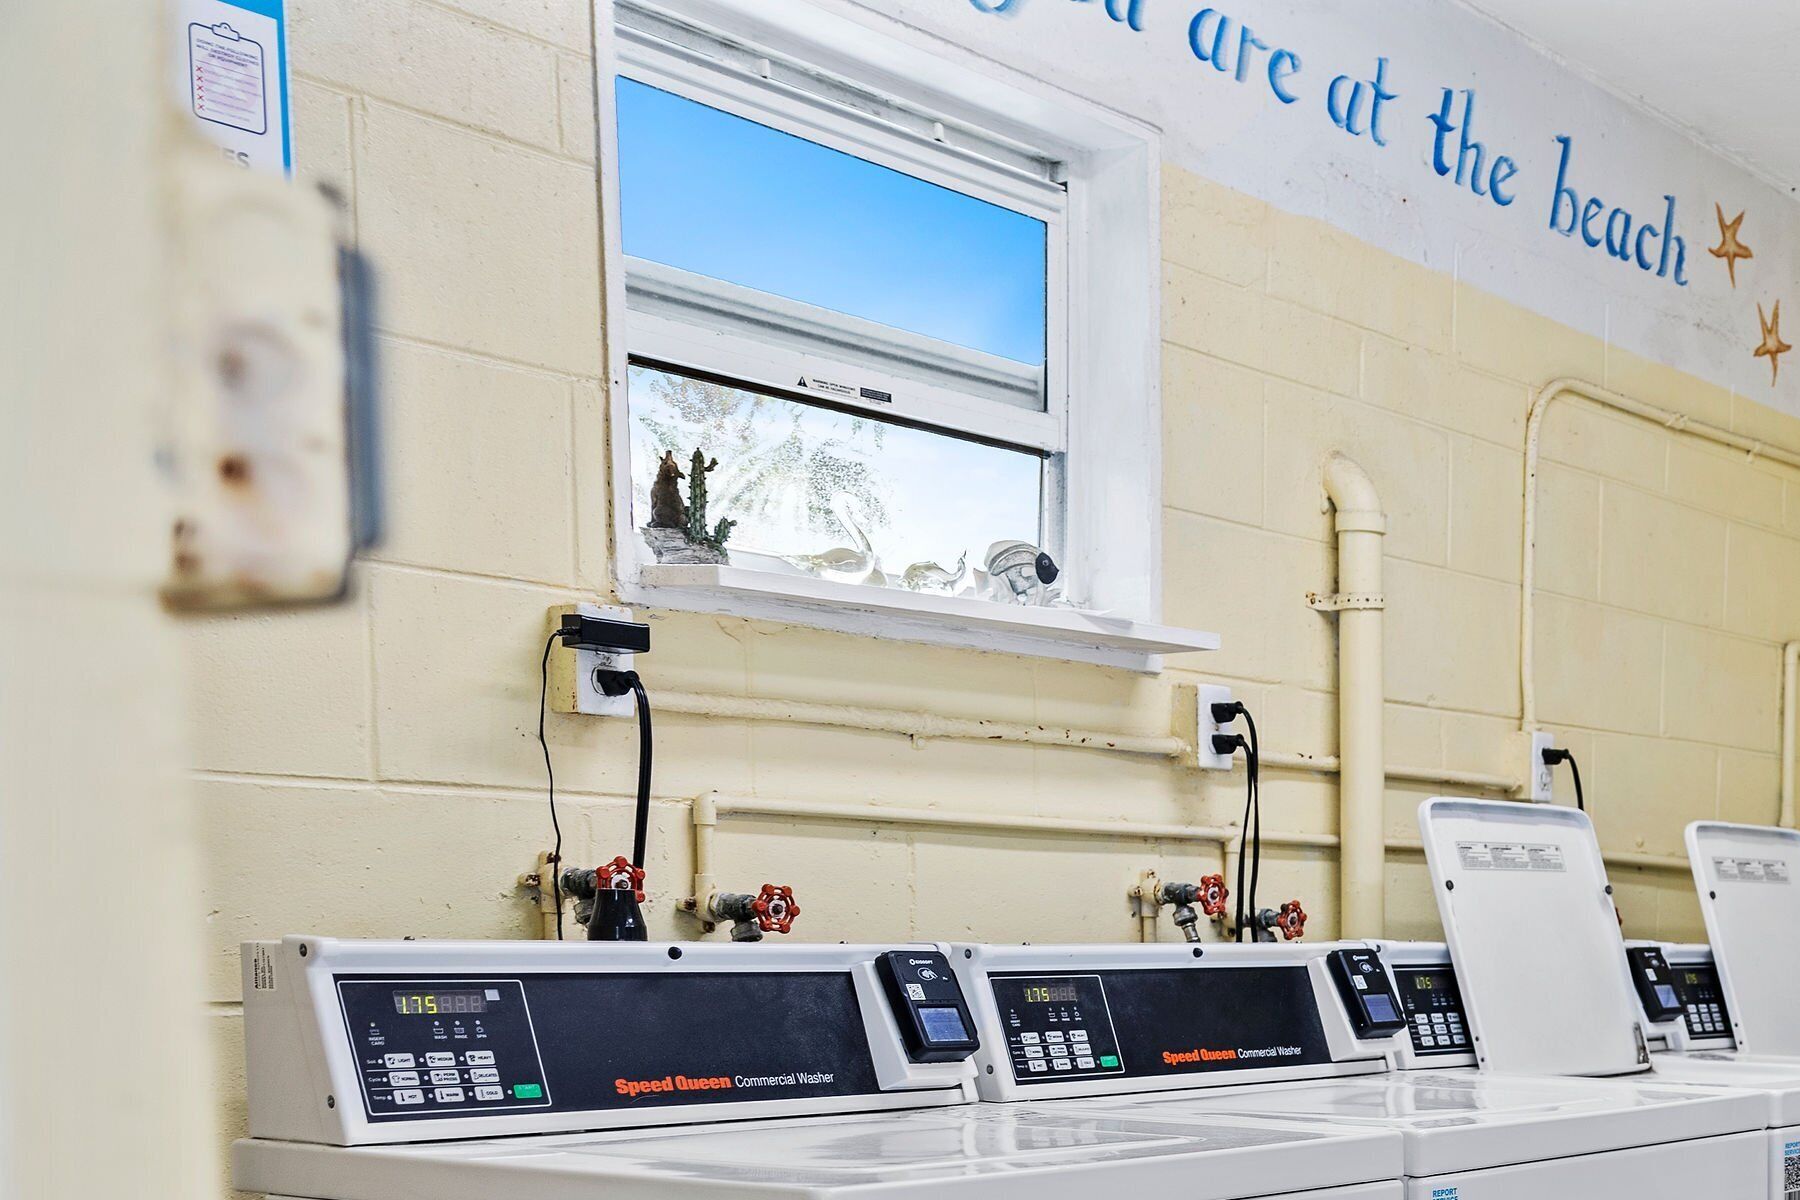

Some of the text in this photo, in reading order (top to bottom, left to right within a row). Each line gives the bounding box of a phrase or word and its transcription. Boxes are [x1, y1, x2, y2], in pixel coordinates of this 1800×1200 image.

[1187, 7, 1688, 286] are at the beach
[402, 995, 438, 1014] 1.75
[1026, 987, 1050, 1002] 1.75
[1162, 1045, 1302, 1066] Speed Queen Commercial Washer
[615, 1071, 834, 1097] Speed Queen Commercial Washer
[1432, 1187, 1458, 1198] REPORT
